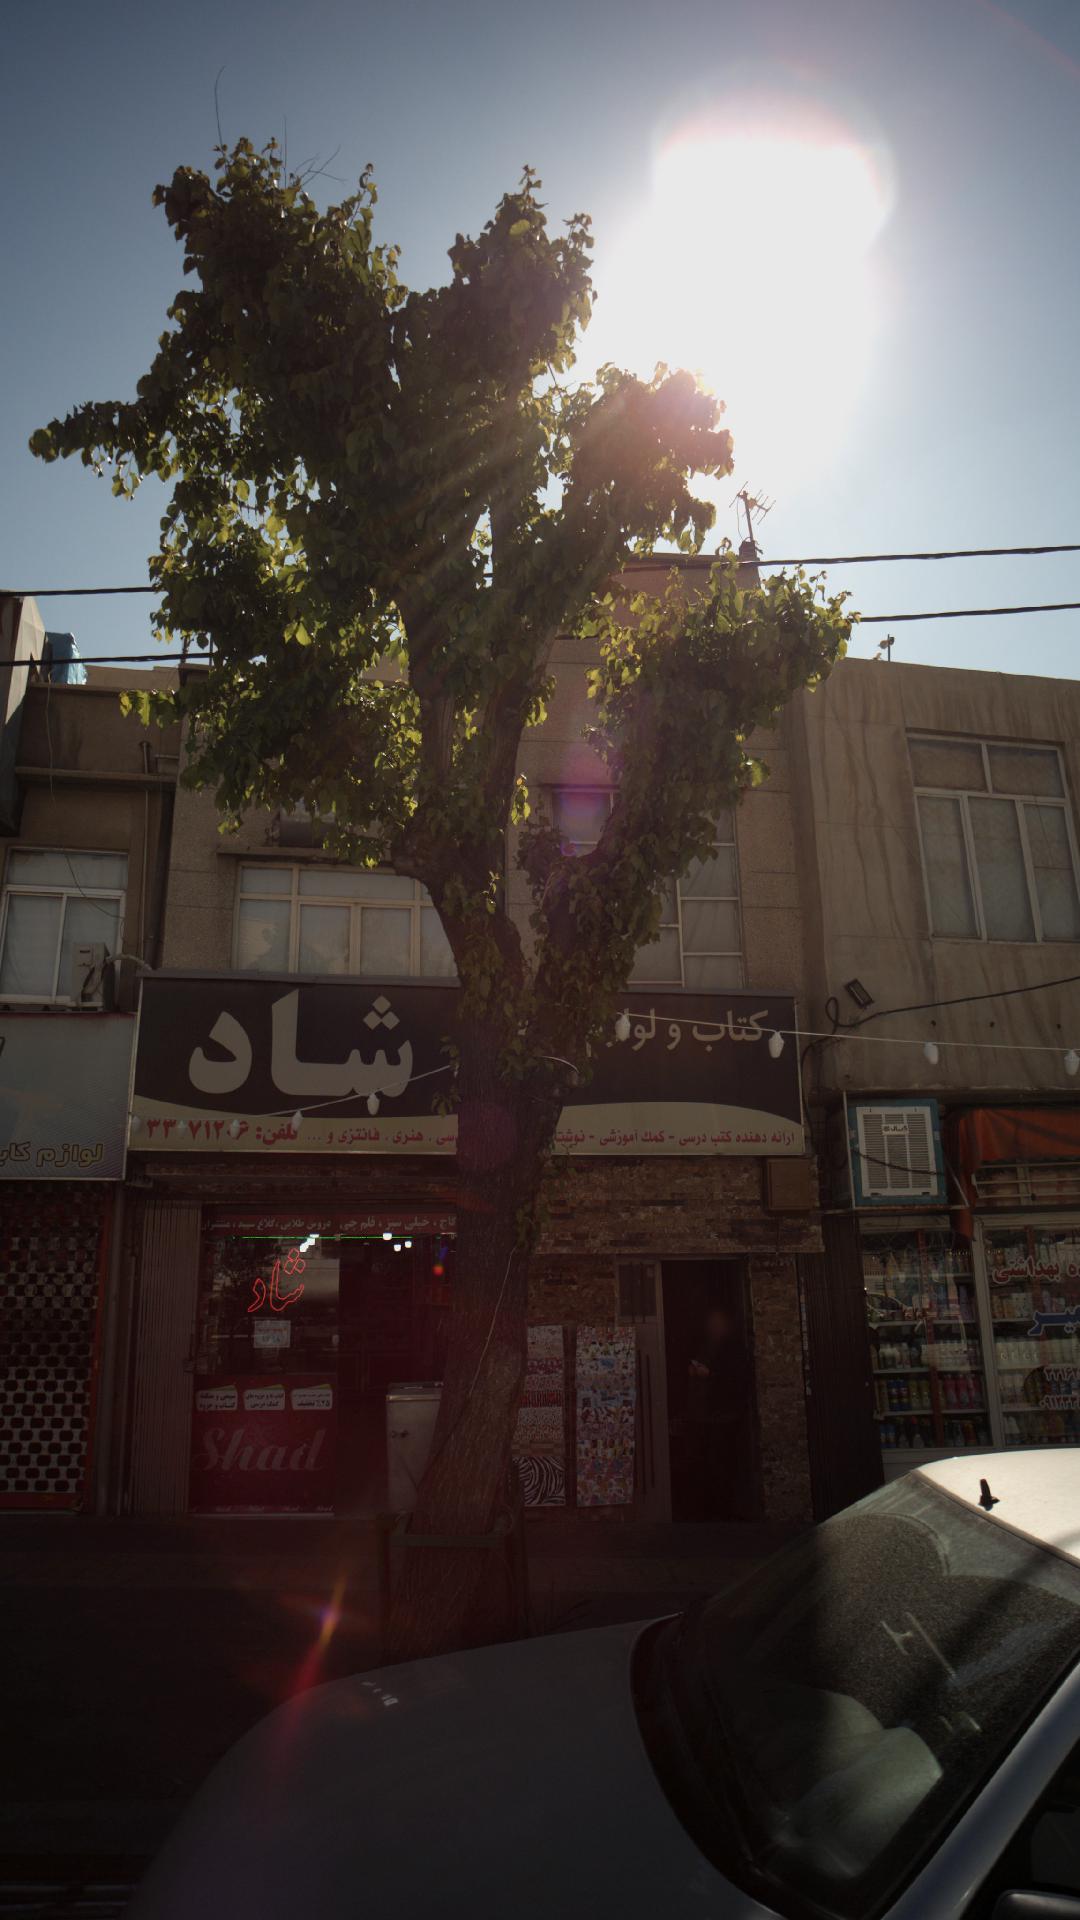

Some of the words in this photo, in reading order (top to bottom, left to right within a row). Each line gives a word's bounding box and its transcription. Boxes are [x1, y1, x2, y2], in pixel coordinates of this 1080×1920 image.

[188, 988, 414, 1098] شاد
[666, 1023, 681, 1051] و
[691, 1010, 769, 1052] کتاب
[337, 1126, 380, 1145] فانتزی
[392, 1128, 424, 1145] هنری
[600, 1128, 638, 1146] آموزشی
[679, 1132, 707, 1147] درسی
[710, 1130, 733, 1147] کتب
[735, 1131, 767, 1144] دهنده
[36, 1143, 104, 1168] لوازم
[247, 1247, 306, 1312] شاد
[992, 1256, 1060, 1284] بهداشتی
[191, 1426, 329, 1472] Shad
